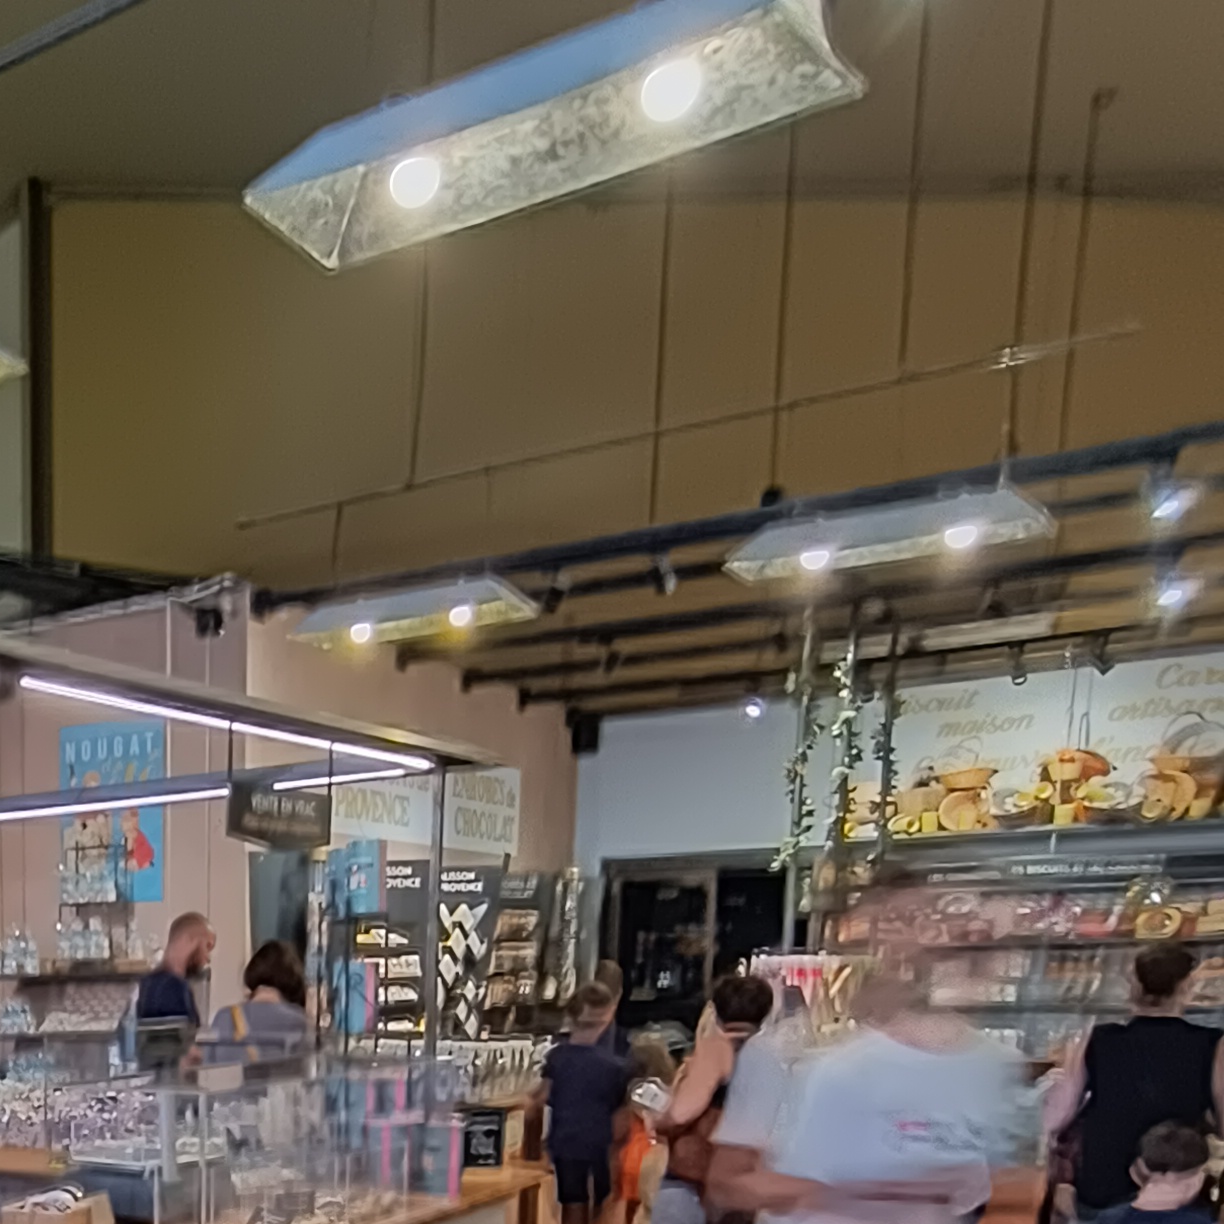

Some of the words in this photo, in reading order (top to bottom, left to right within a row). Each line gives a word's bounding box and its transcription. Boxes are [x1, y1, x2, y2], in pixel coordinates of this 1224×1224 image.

[935, 711, 1036, 739] maison
[65, 731, 154, 765] NOUGAT
[333, 785, 411, 828] PROVENCE
